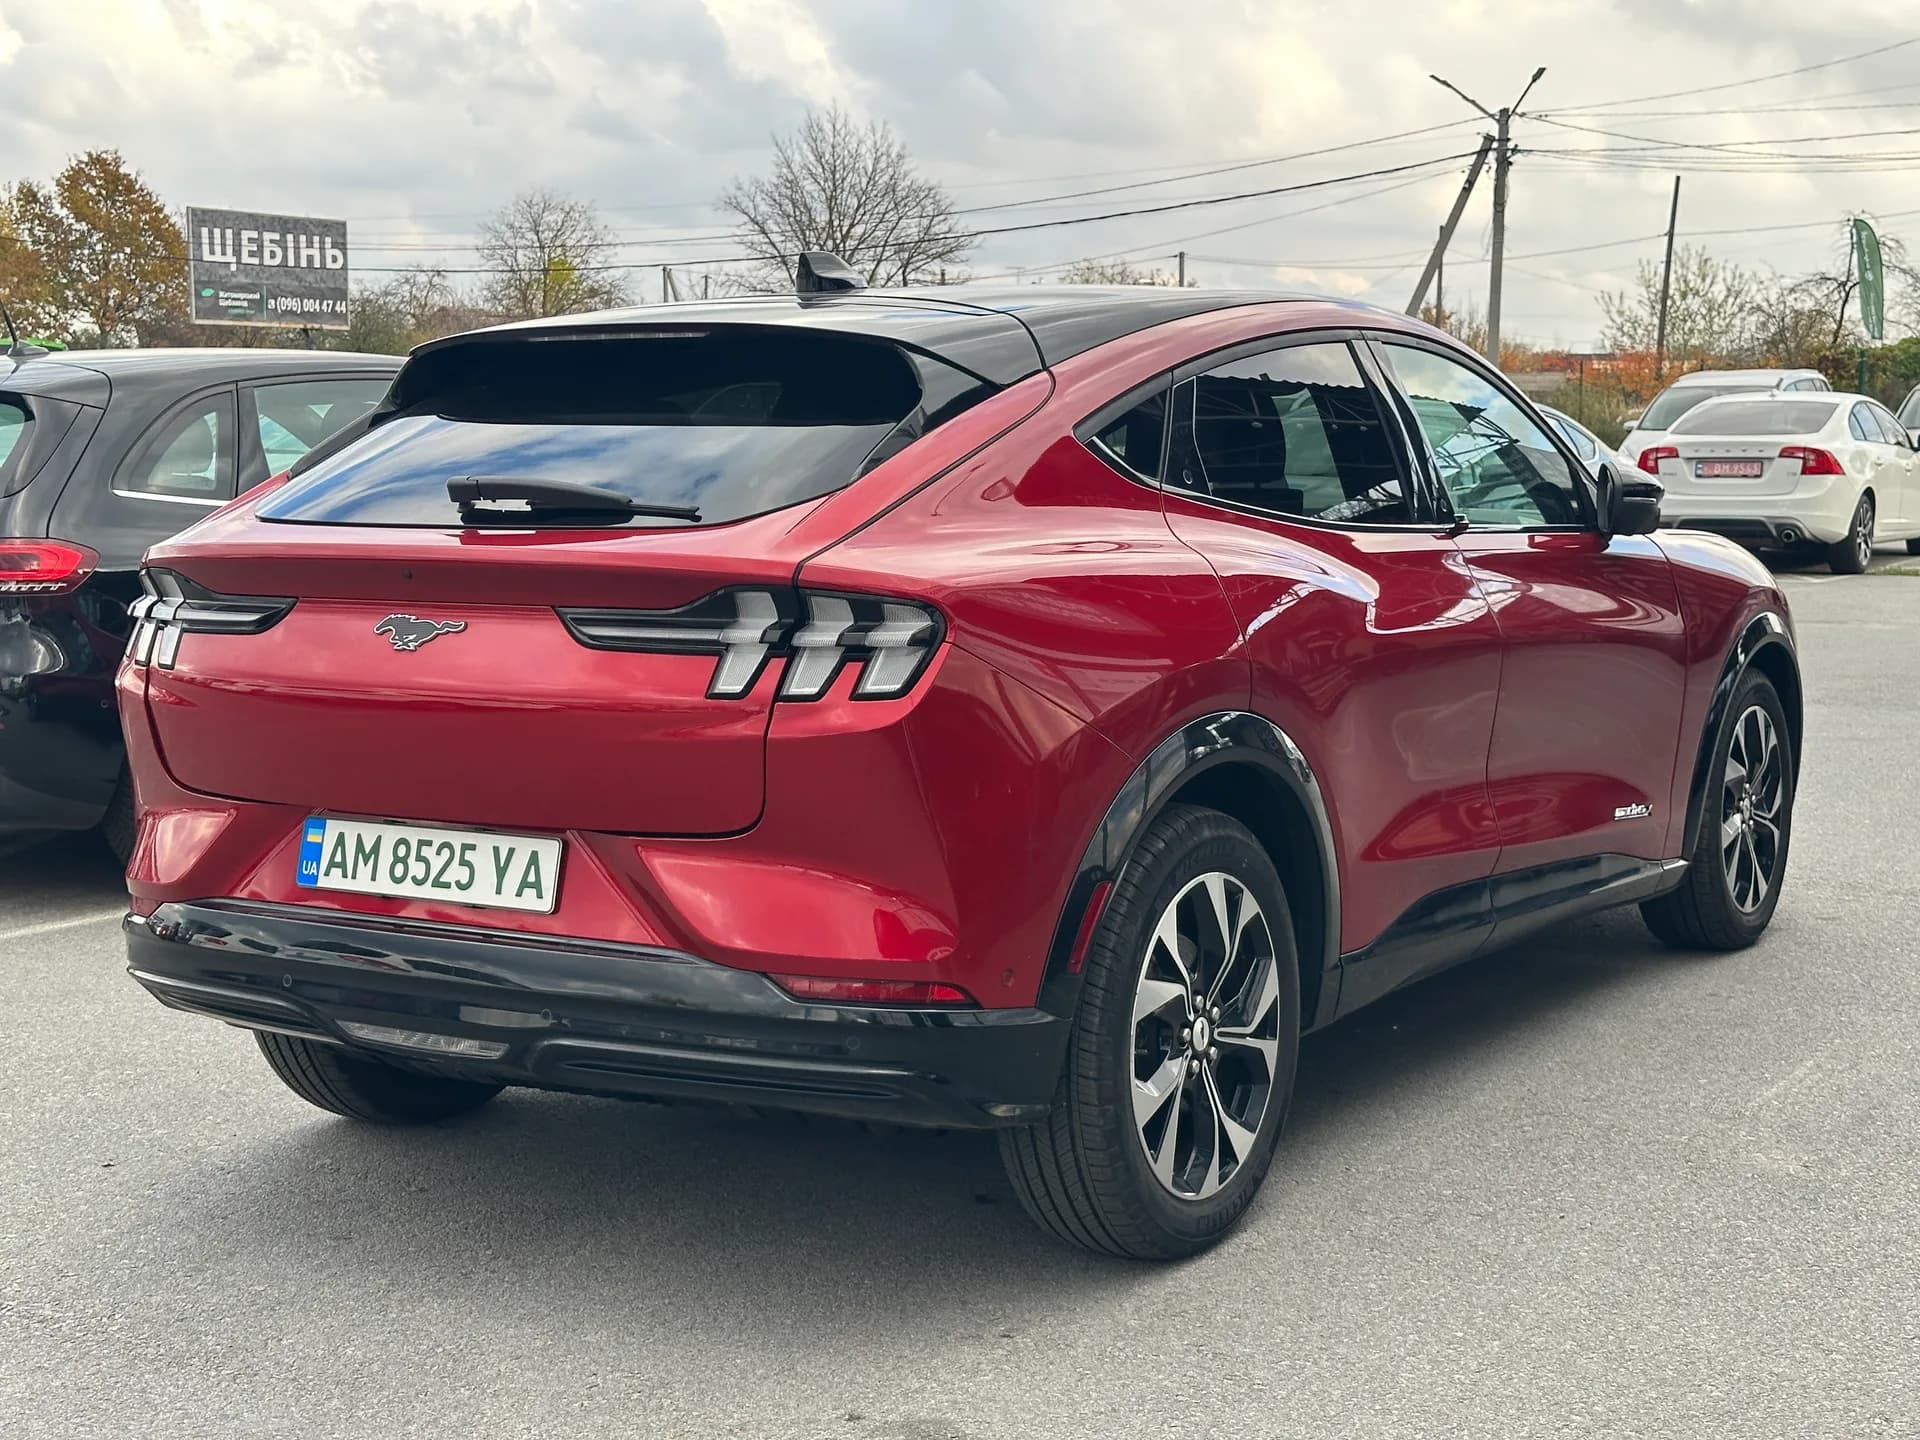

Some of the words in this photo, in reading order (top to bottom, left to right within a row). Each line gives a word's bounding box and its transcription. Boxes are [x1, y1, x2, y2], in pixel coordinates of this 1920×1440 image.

[201, 227, 344, 271] ЩЕБІНЬ
[276, 296, 301, 314] (096)
[303, 298, 320, 312] 004
[321, 299, 334, 313] 47
[334, 300, 346, 314] 44
[302, 860, 318, 876] UA
[323, 831, 382, 882] AM
[389, 836, 477, 891] 8525
[492, 845, 544, 899] YA
